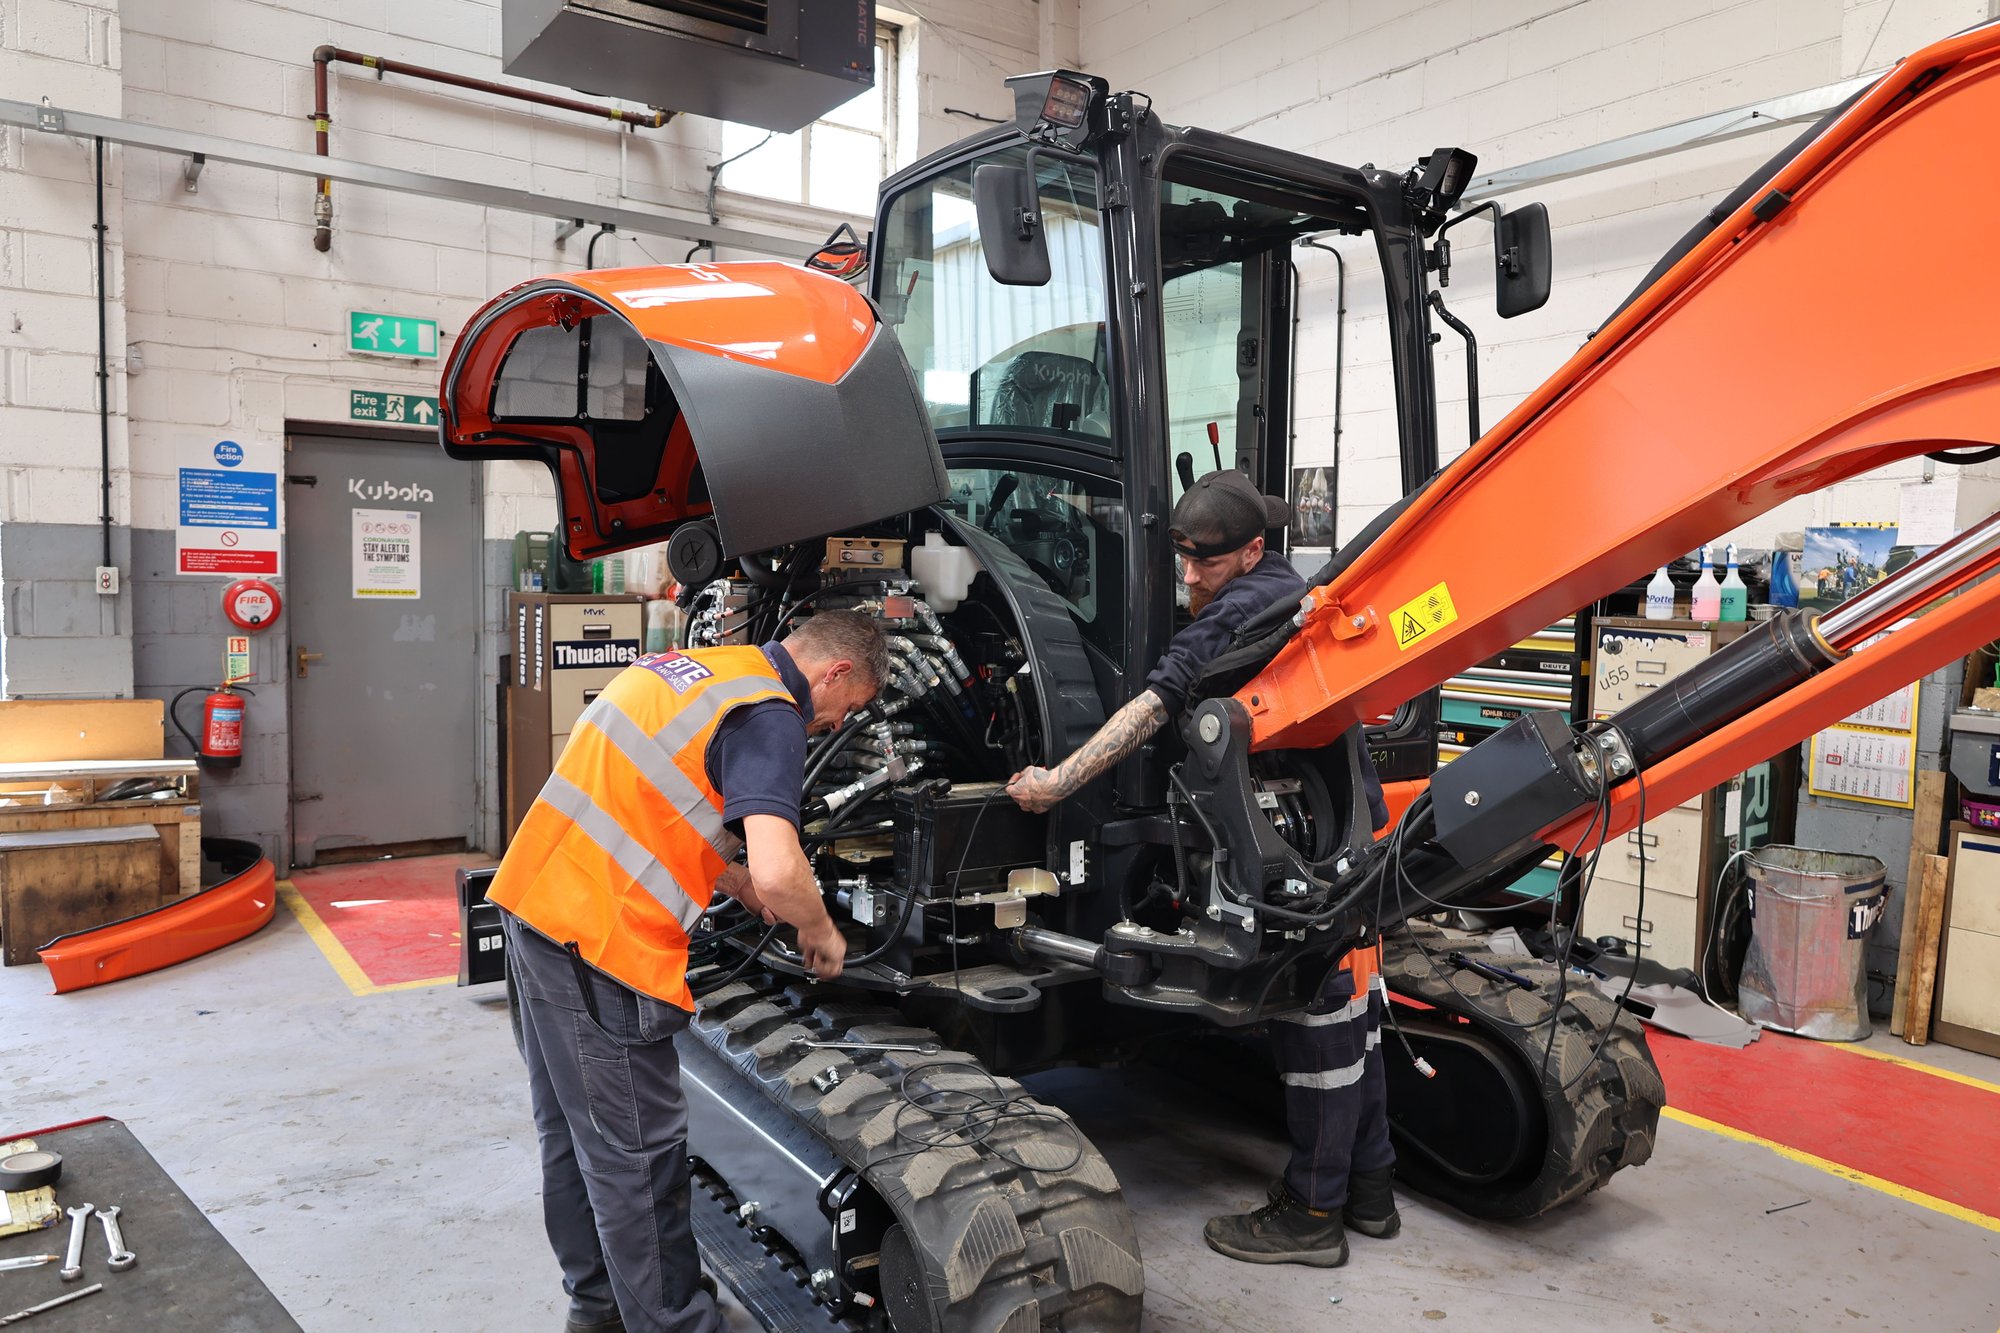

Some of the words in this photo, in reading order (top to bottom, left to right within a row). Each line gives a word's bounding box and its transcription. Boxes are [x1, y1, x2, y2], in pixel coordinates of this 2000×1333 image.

[1035, 363, 1091, 385] Kubota
[353, 393, 378, 405] Fire
[354, 407, 378, 417] exit
[221, 445, 237, 453] Fire
[348, 478, 434, 503] Kubota
[363, 543, 379, 552] STAY
[380, 544, 400, 553] ALERT
[401, 544, 410, 553] TO
[363, 553, 375, 561] THE
[376, 553, 410, 563] SYMPTOMS
[239, 596, 267, 604] FIRE
[519, 606, 527, 685] Thwaites
[555, 643, 638, 665] Thwaites
[664, 656, 711, 685] BTE
[1542, 662, 1568, 670] DEUTZ
[667, 674, 688, 693] SALES
[1482, 709, 1503, 718] KOHLER
[1503, 710, 1520, 719] DIESEL
